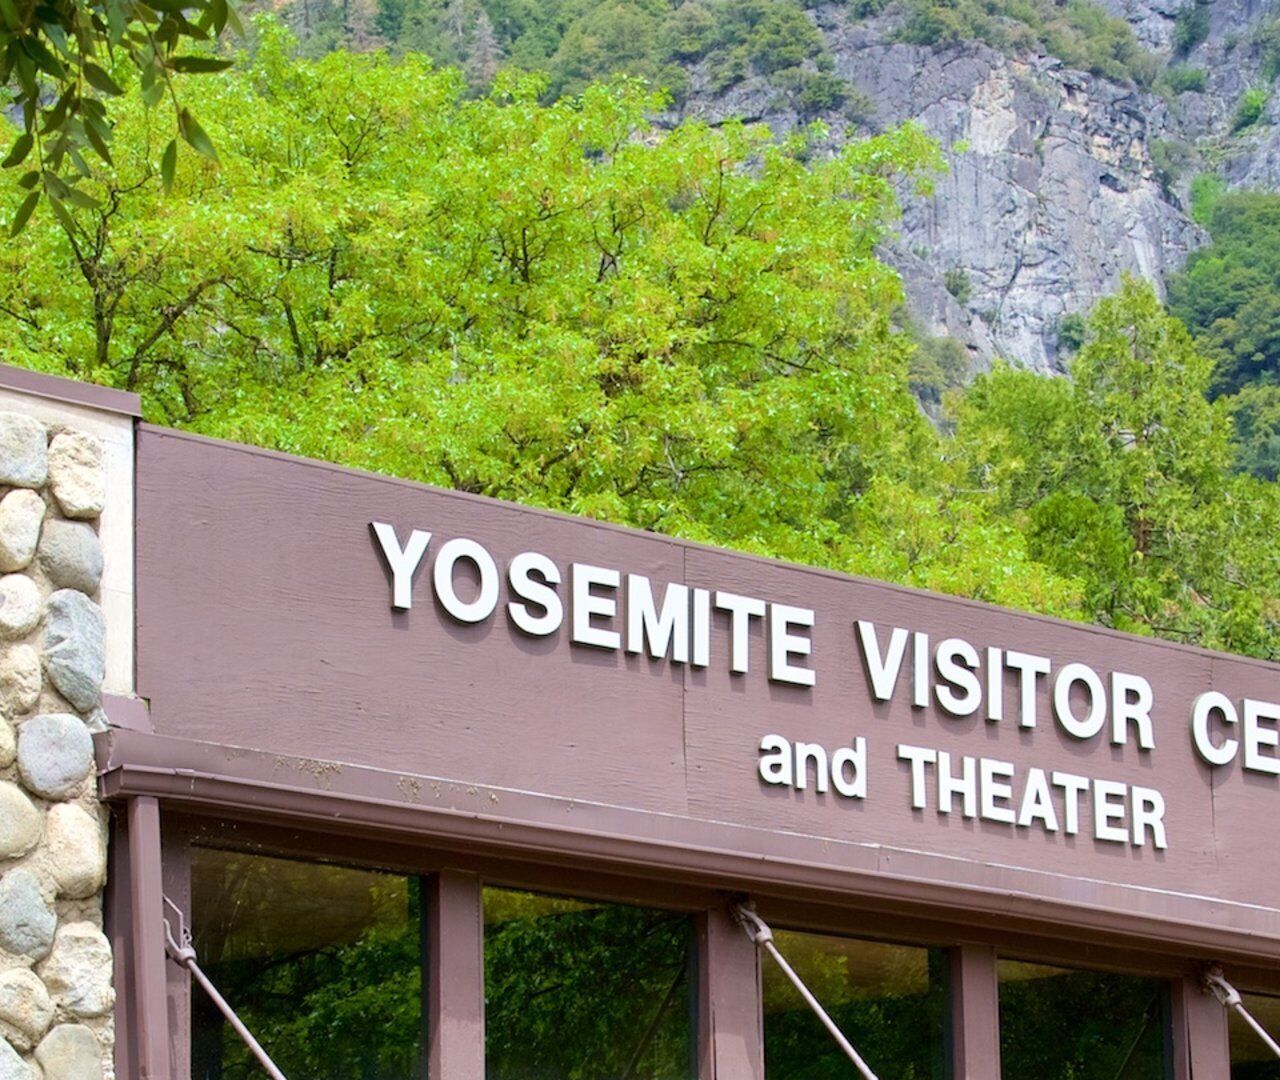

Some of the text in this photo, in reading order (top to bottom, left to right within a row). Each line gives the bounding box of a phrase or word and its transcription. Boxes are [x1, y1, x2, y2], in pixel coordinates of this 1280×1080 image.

[369, 520, 816, 687] YOSEMITE
[854, 620, 1156, 749] VISITOR
[758, 733, 1168, 850] and THEATER
